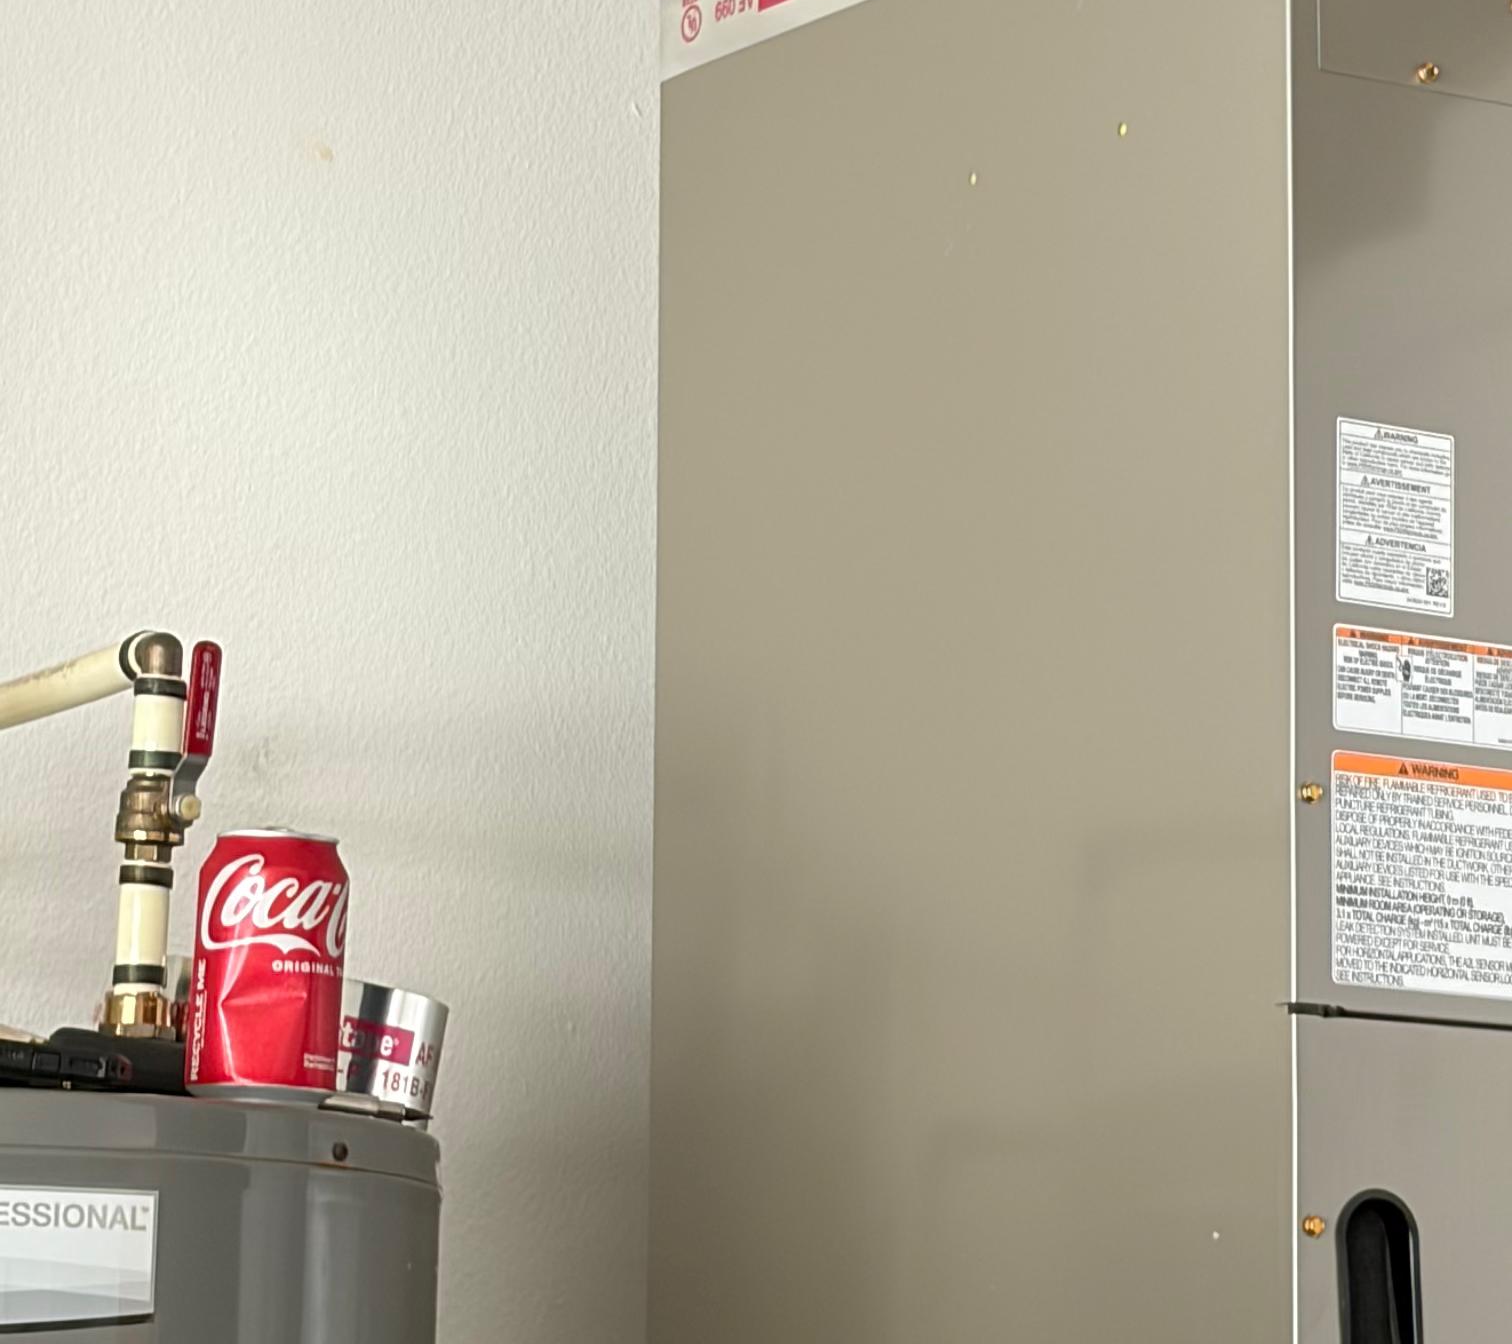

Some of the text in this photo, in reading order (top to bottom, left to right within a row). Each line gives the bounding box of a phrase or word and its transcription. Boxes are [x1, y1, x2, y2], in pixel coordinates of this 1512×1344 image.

[1383, 431, 1418, 445] WARNING
[1370, 477, 1431, 494] AVERTISSEMENT
[1375, 538, 1427, 553] ADVERTENCIA
[1411, 763, 1459, 781] WARNING
[272, 959, 335, 977] ORIGINAL
